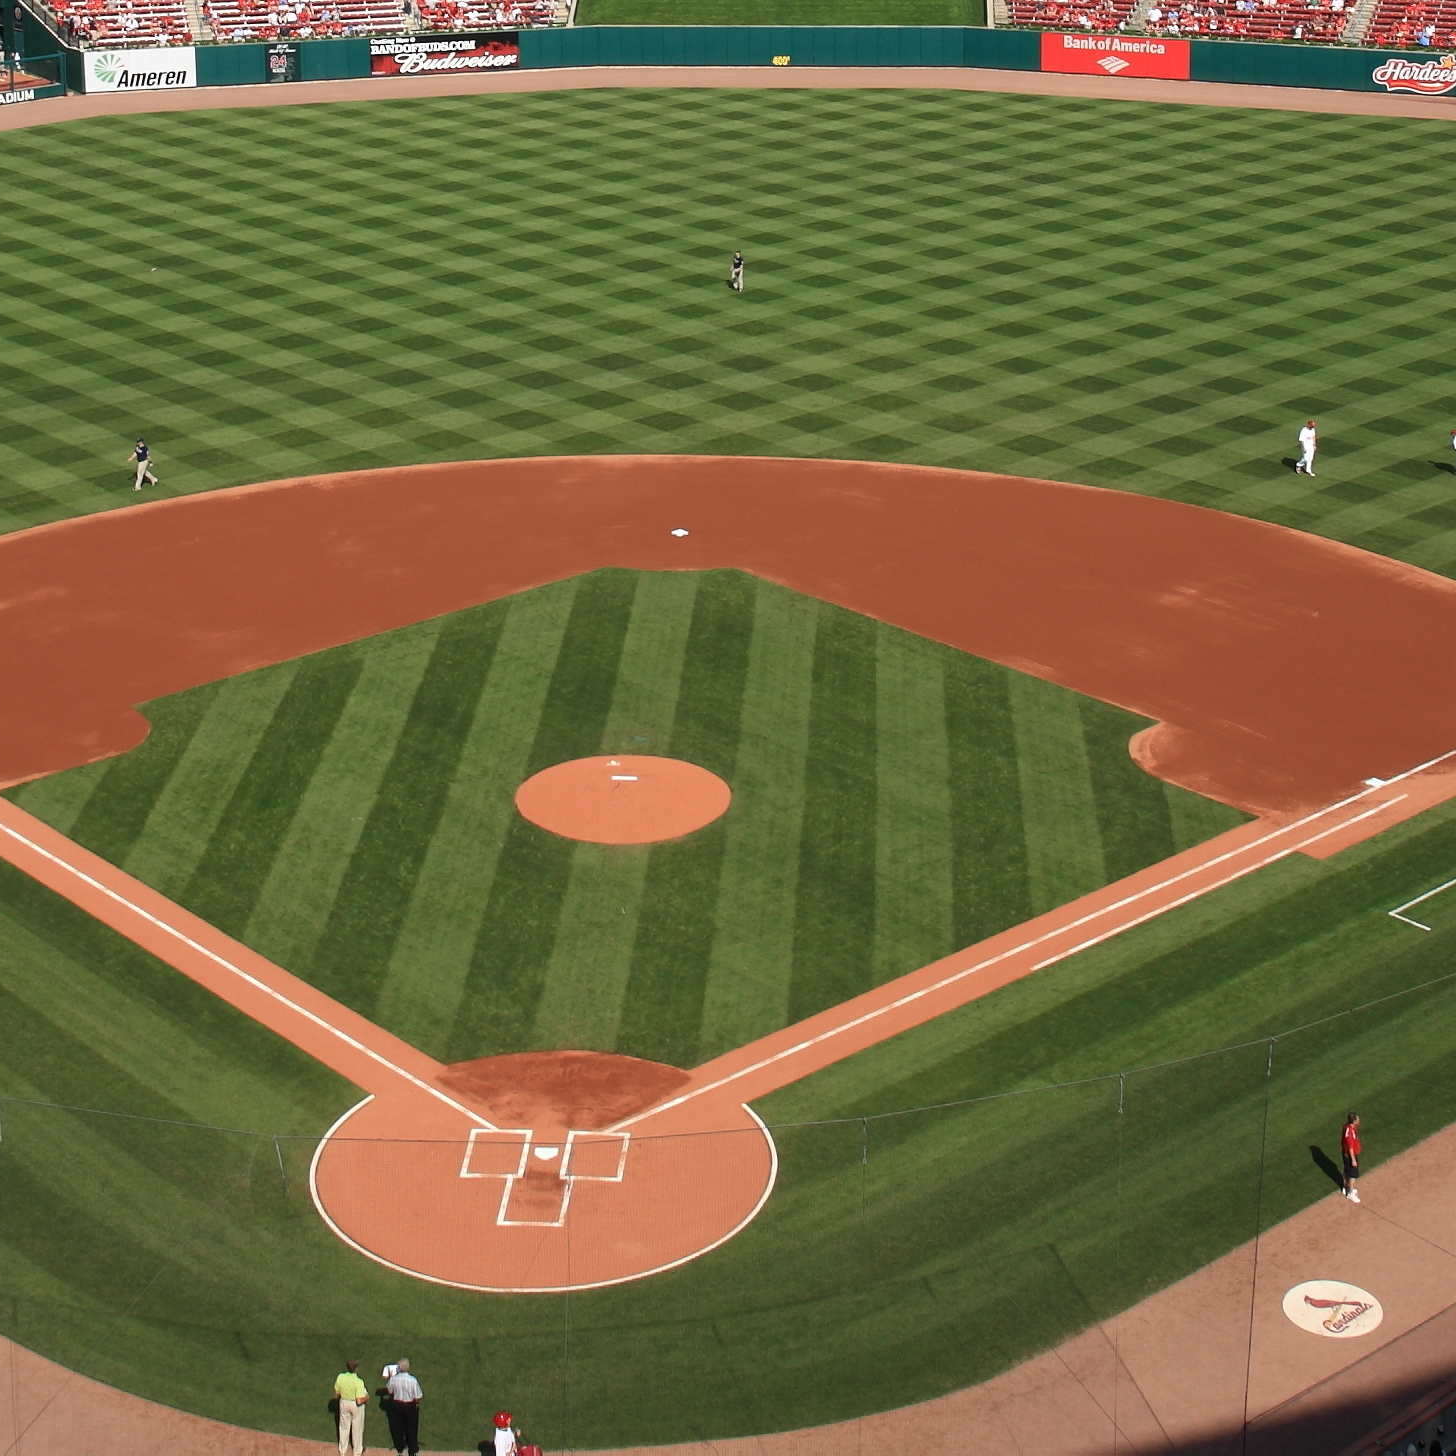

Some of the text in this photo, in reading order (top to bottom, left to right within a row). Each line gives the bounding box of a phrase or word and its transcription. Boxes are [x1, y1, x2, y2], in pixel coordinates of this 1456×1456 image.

[370, 40, 476, 55] BANDOFBUDS.COM
[1063, 35, 1166, 55] Bank of America
[269, 55, 288, 69] 24
[395, 51, 518, 74] Budweiser
[117, 69, 187, 88] Ameren
[1323, 1301, 1374, 1333] Cardinals
